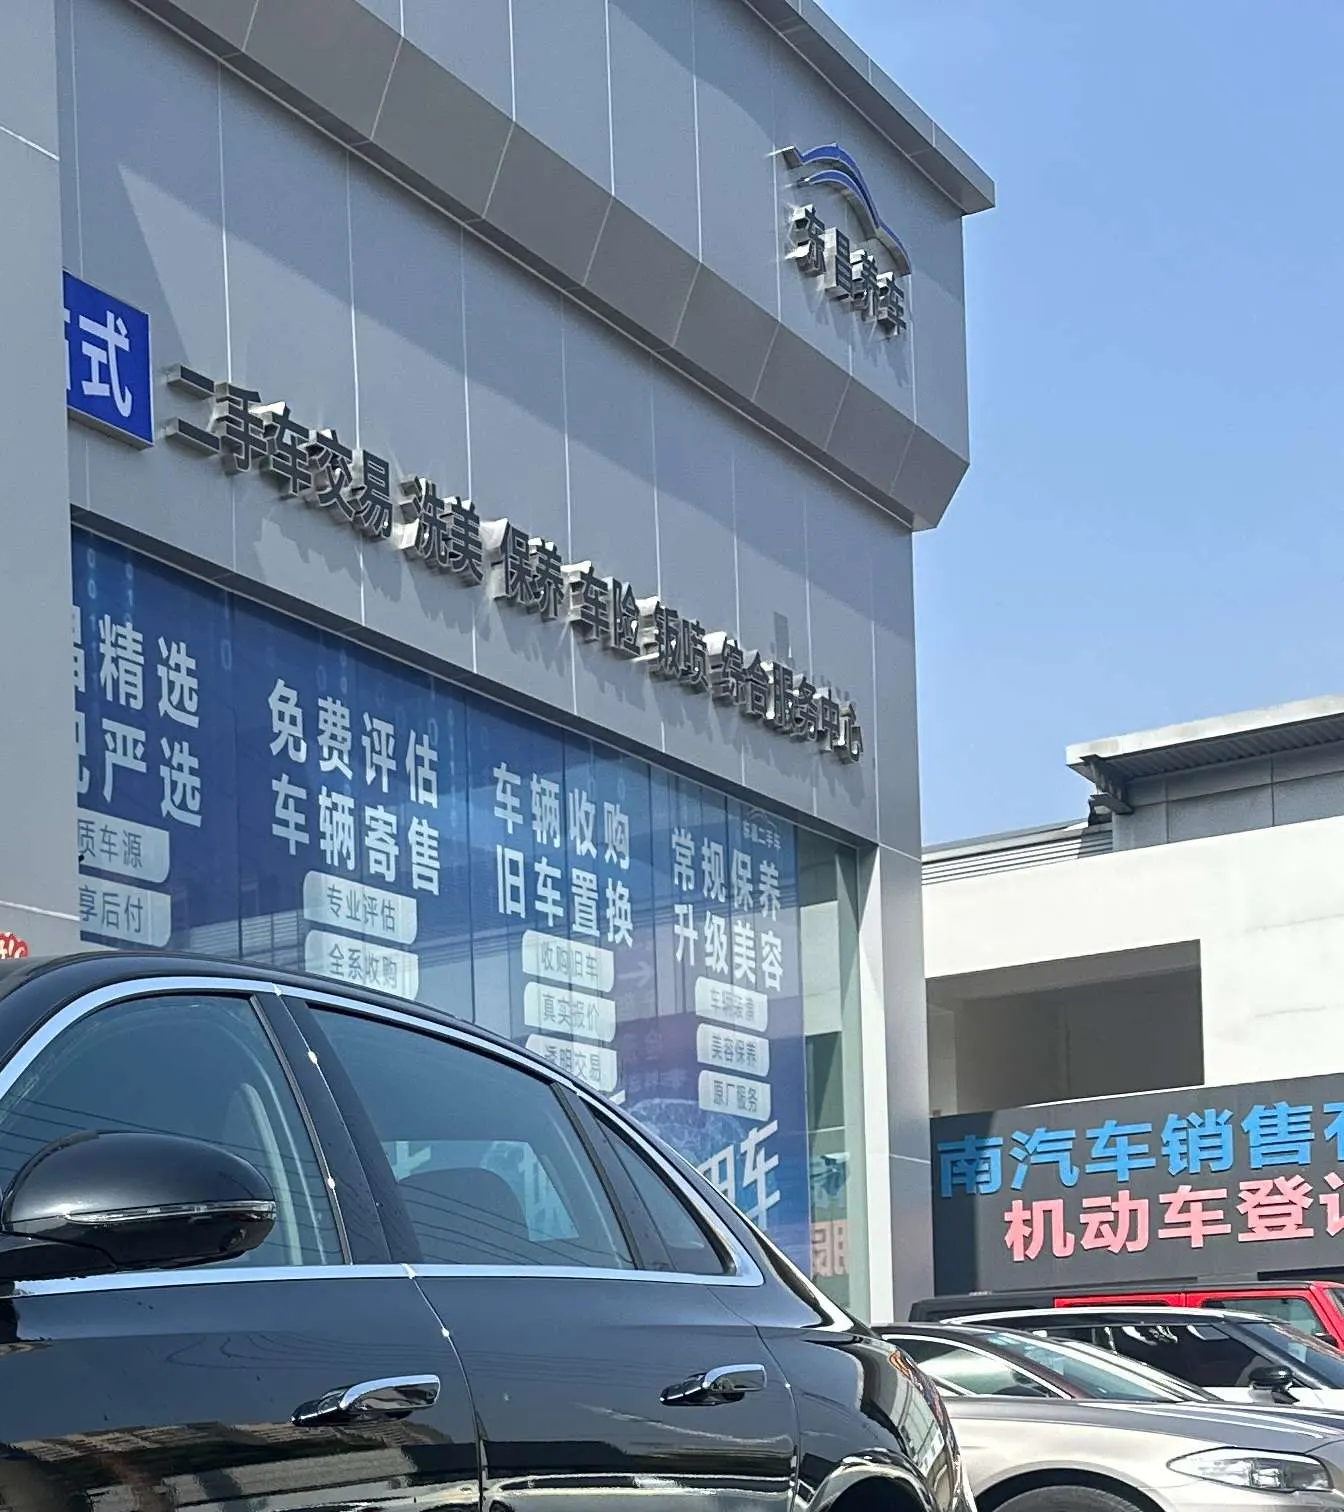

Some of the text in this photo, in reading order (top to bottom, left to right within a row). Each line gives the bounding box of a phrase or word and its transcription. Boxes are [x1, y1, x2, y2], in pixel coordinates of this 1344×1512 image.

[64, 308, 132, 418] 式
[178, 364, 393, 540] 二手车交易
[268, 679, 439, 809] 免费评估
[272, 774, 441, 896] 车辆寄售
[493, 763, 630, 870] 车辆收购
[326, 883, 397, 933] 专业评估
[496, 844, 633, 948] 旧车置换
[671, 827, 781, 921] 常规保养
[328, 942, 398, 988] 全系收购
[673, 903, 784, 992] 升级美容
